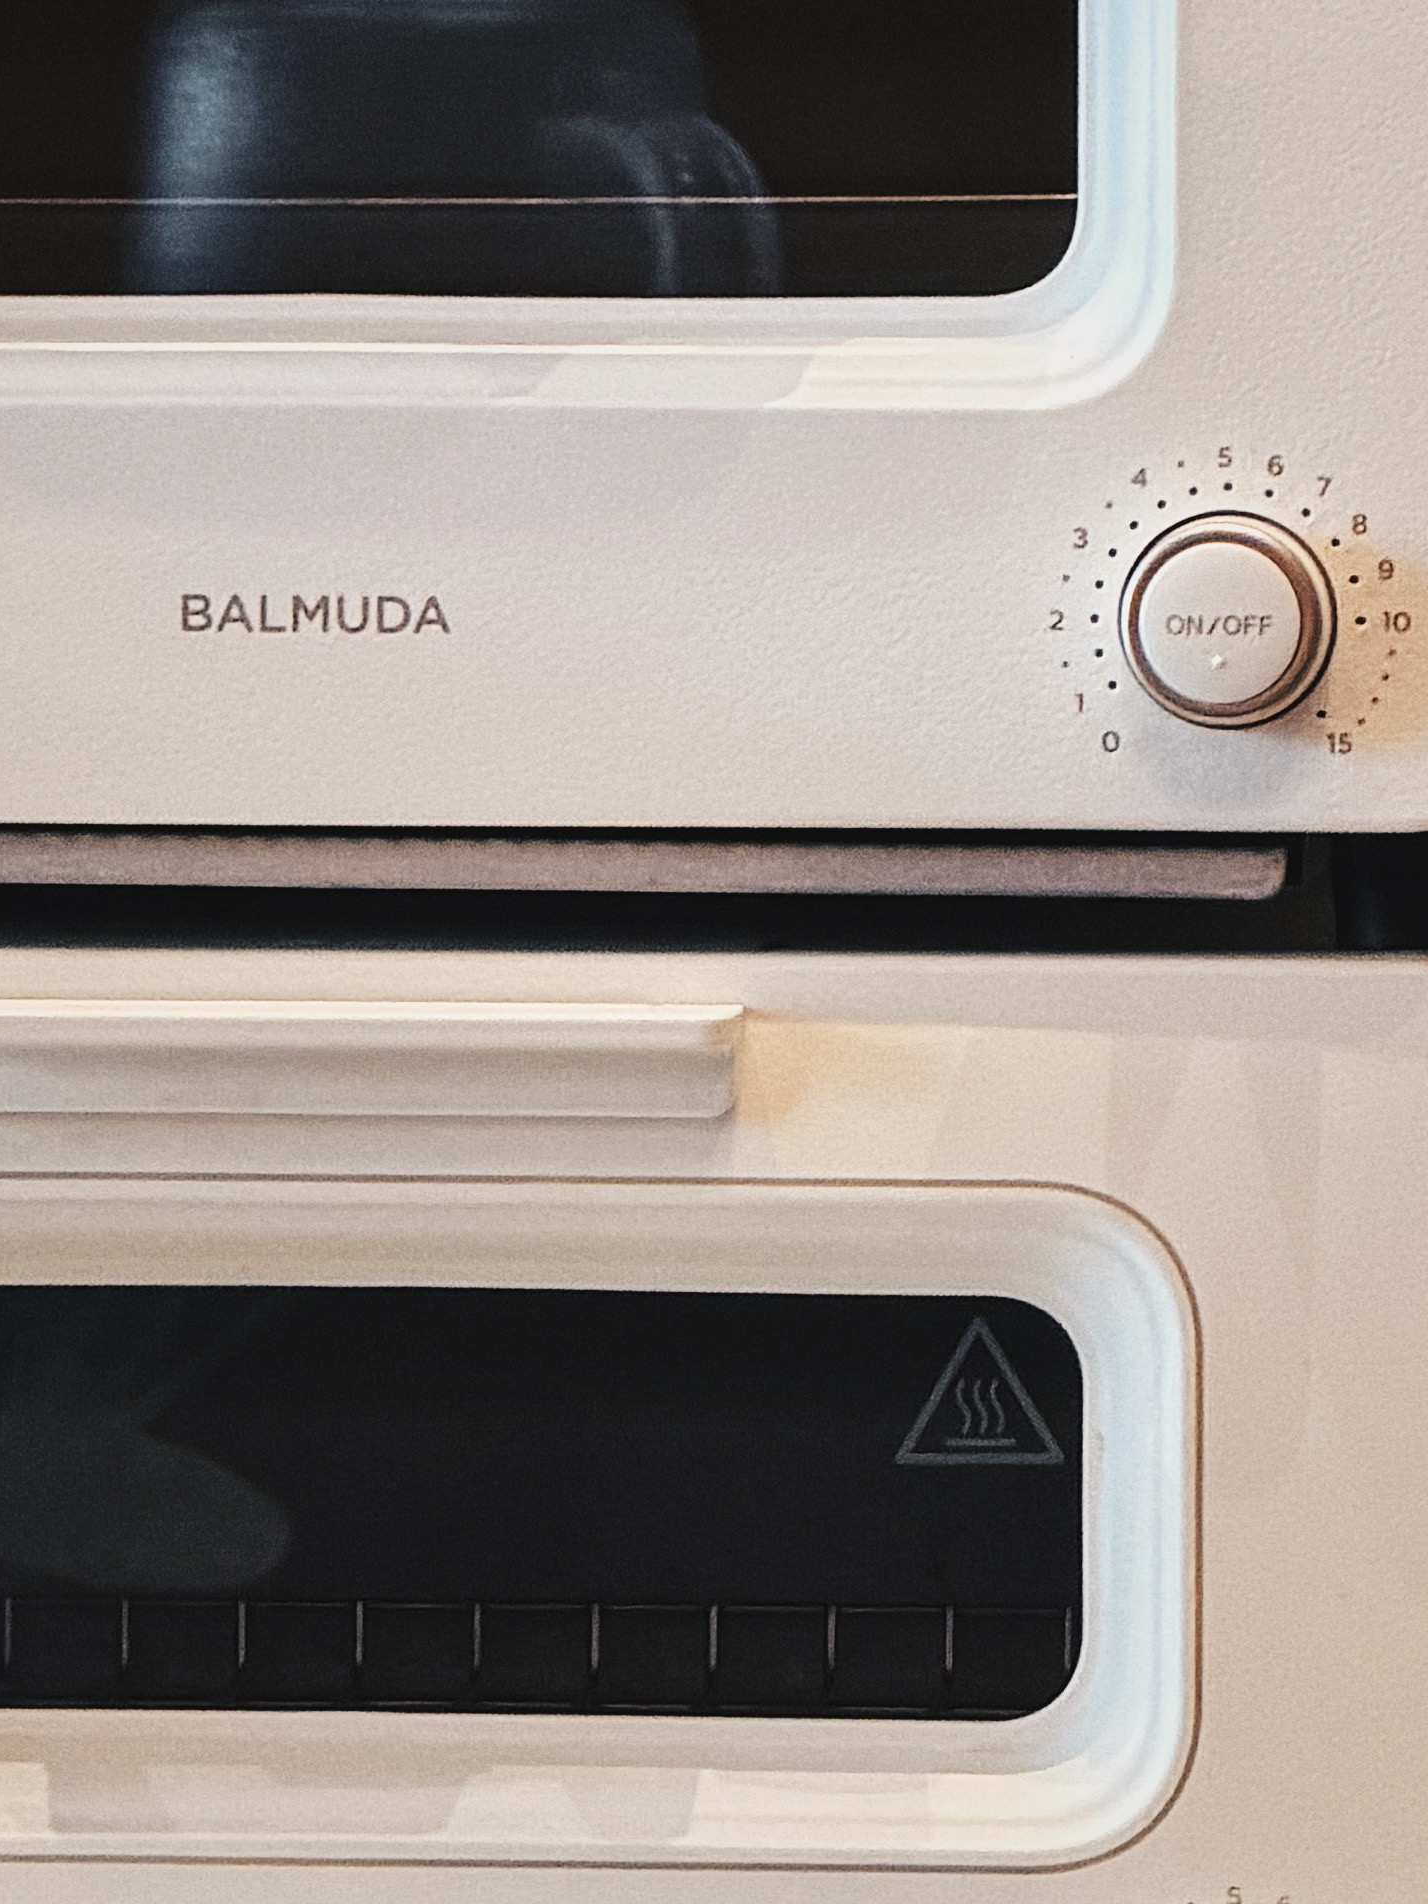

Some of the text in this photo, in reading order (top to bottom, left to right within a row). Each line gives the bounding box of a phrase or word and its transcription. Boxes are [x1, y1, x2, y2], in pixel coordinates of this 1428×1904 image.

[1218, 446, 1232, 468] 5
[1268, 454, 1284, 476] 6
[1131, 467, 1149, 488] 4
[1317, 476, 1333, 497] 7
[1352, 514, 1368, 536] 8
[1073, 528, 1088, 549] 3
[1378, 558, 1394, 580] 9
[180, 593, 451, 634] BALMUDA
[1049, 610, 1065, 632] 2
[1383, 611, 1411, 634] 10
[1165, 614, 1273, 637] ON/OFF
[1076, 693, 1085, 713] 1
[1102, 730, 1120, 753] 0
[1326, 733, 1353, 755] 15
